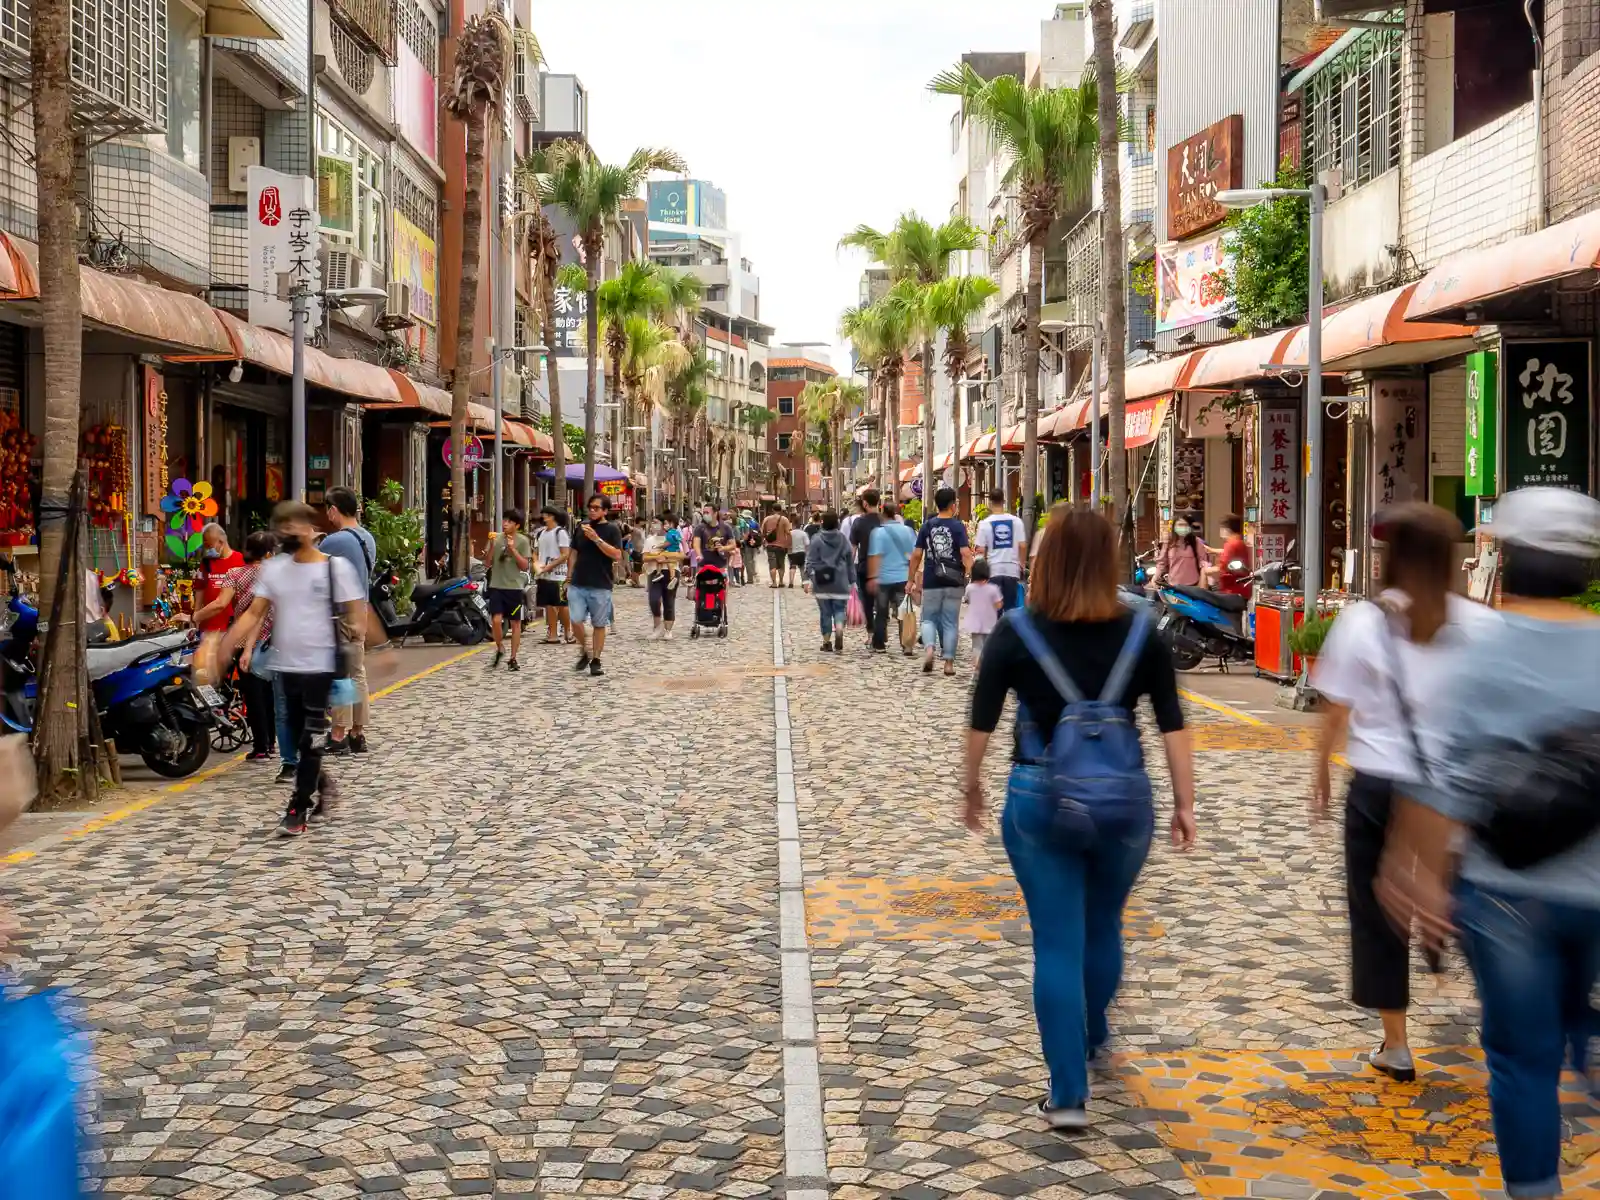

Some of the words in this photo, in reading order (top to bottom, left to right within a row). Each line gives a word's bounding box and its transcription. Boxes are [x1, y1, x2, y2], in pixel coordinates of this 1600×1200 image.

[660, 208, 688, 216] Thinker
[1270, 428, 1291, 519] 餐具批發
[1265, 536, 1274, 563] 上下
